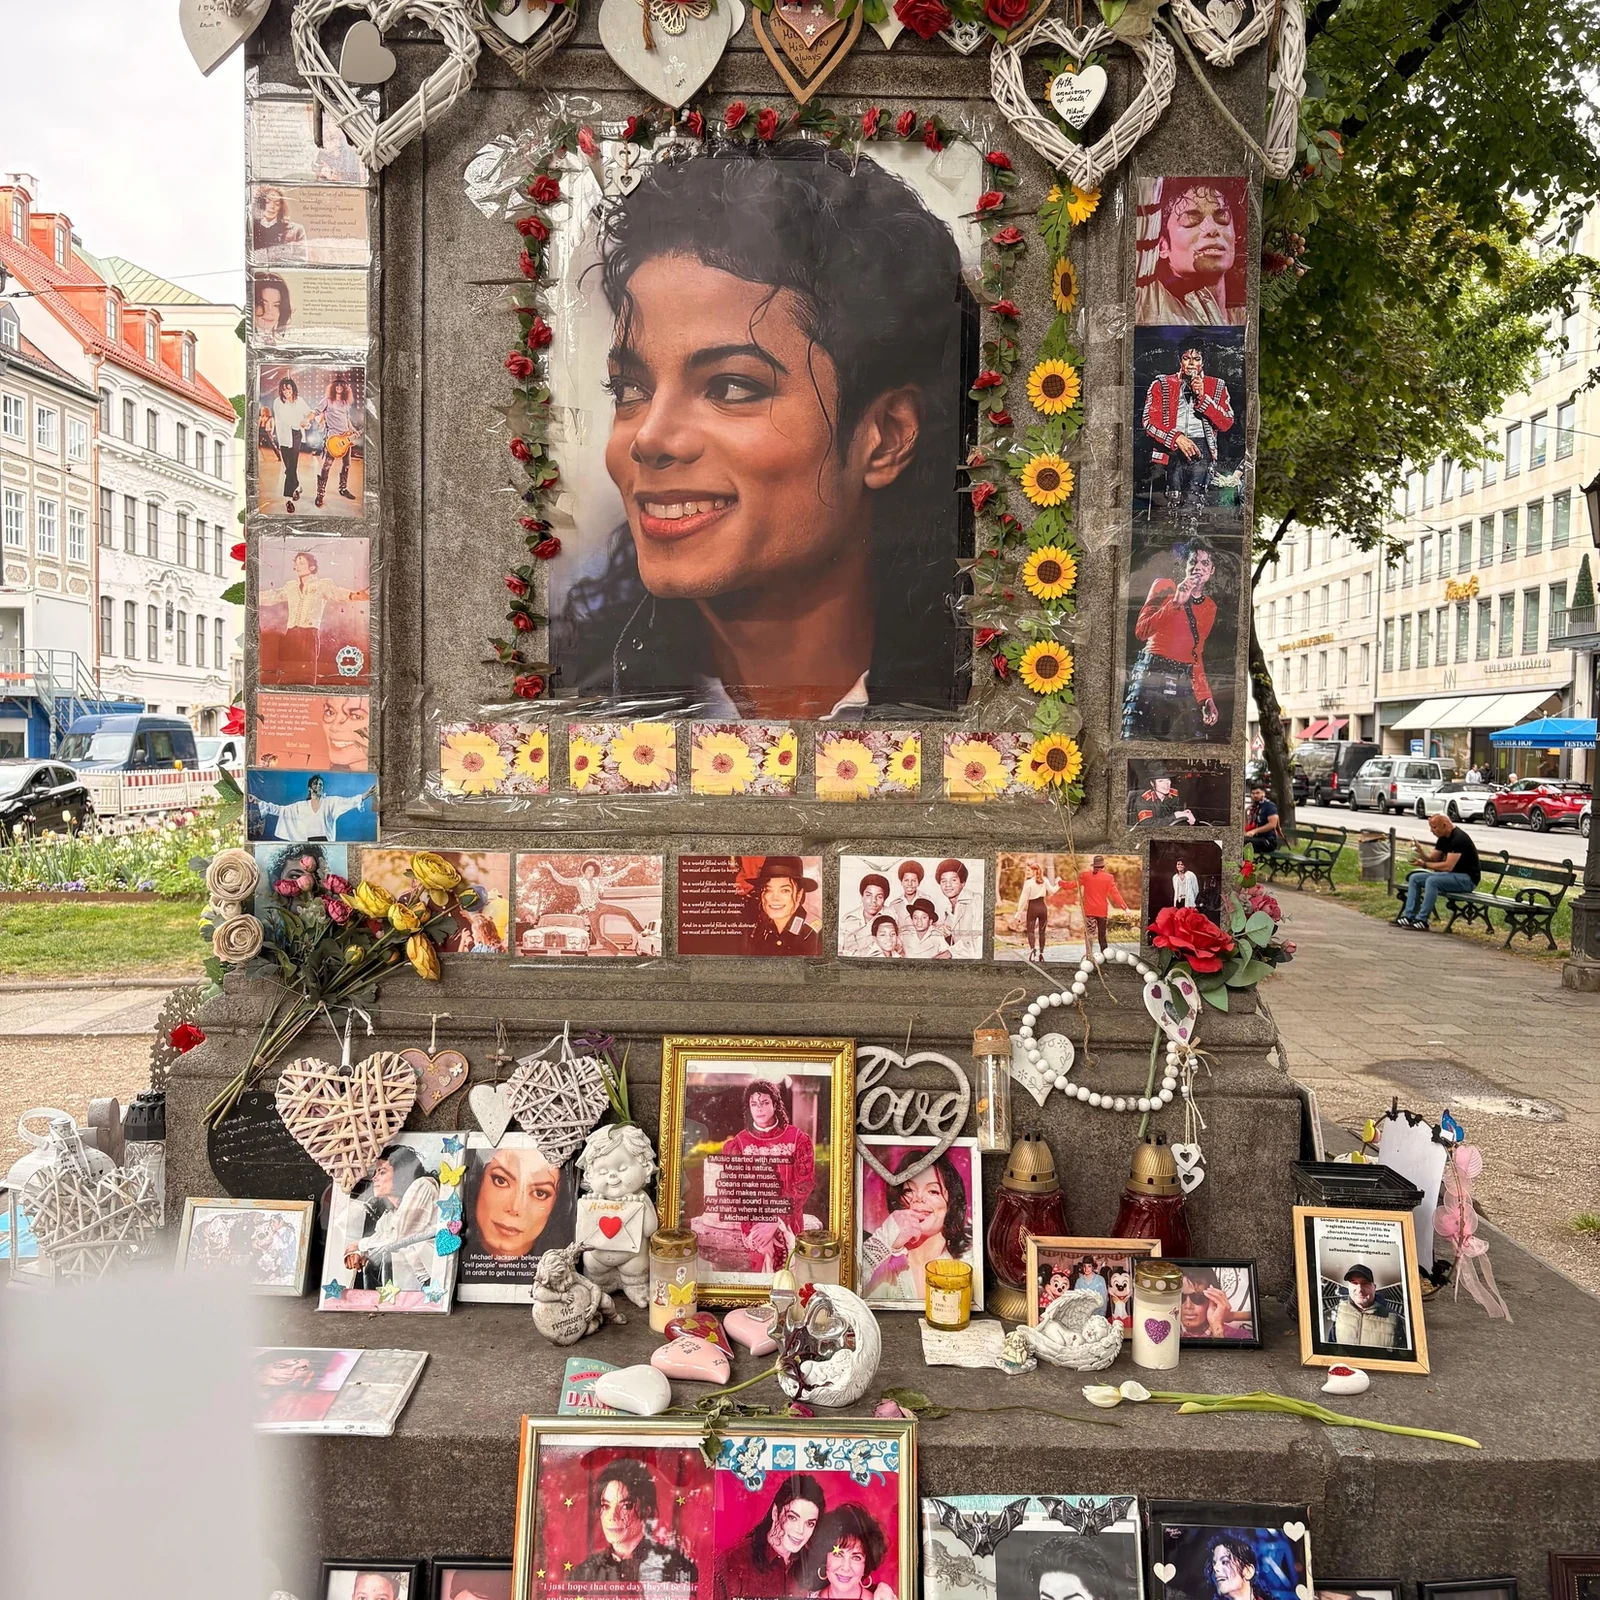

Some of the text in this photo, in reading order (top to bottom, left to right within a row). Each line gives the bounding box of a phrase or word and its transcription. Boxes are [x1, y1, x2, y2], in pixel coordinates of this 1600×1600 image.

[1216, 9, 1234, 28] MJ
[794, 53, 822, 65] always
[1518, 739, 1533, 747] HOF
[704, 860, 717, 868] filled
[704, 901, 717, 909] filled
[714, 922, 727, 930] filled
[768, 1156, 791, 1164] nature.
[724, 1163, 744, 1171] Music
[751, 1164, 774, 1172] nature.
[759, 1181, 781, 1189] music.
[718, 1188, 735, 1196] Wind
[757, 1189, 779, 1197] music.
[705, 1197, 718, 1206] Any
[718, 1197, 741, 1205] natural
[742, 1197, 762, 1205] sound
[705, 1205, 719, 1213] And
[750, 1214, 777, 1222] Jackson
[551, 1314, 583, 1331] vermissen
[548, 1582, 566, 1592] just
[567, 1582, 588, 1592] hope
[590, 1582, 607, 1591] that
[626, 1582, 641, 1592] day
[643, 1582, 669, 1592] they'll
[670, 1582, 681, 1591] be
